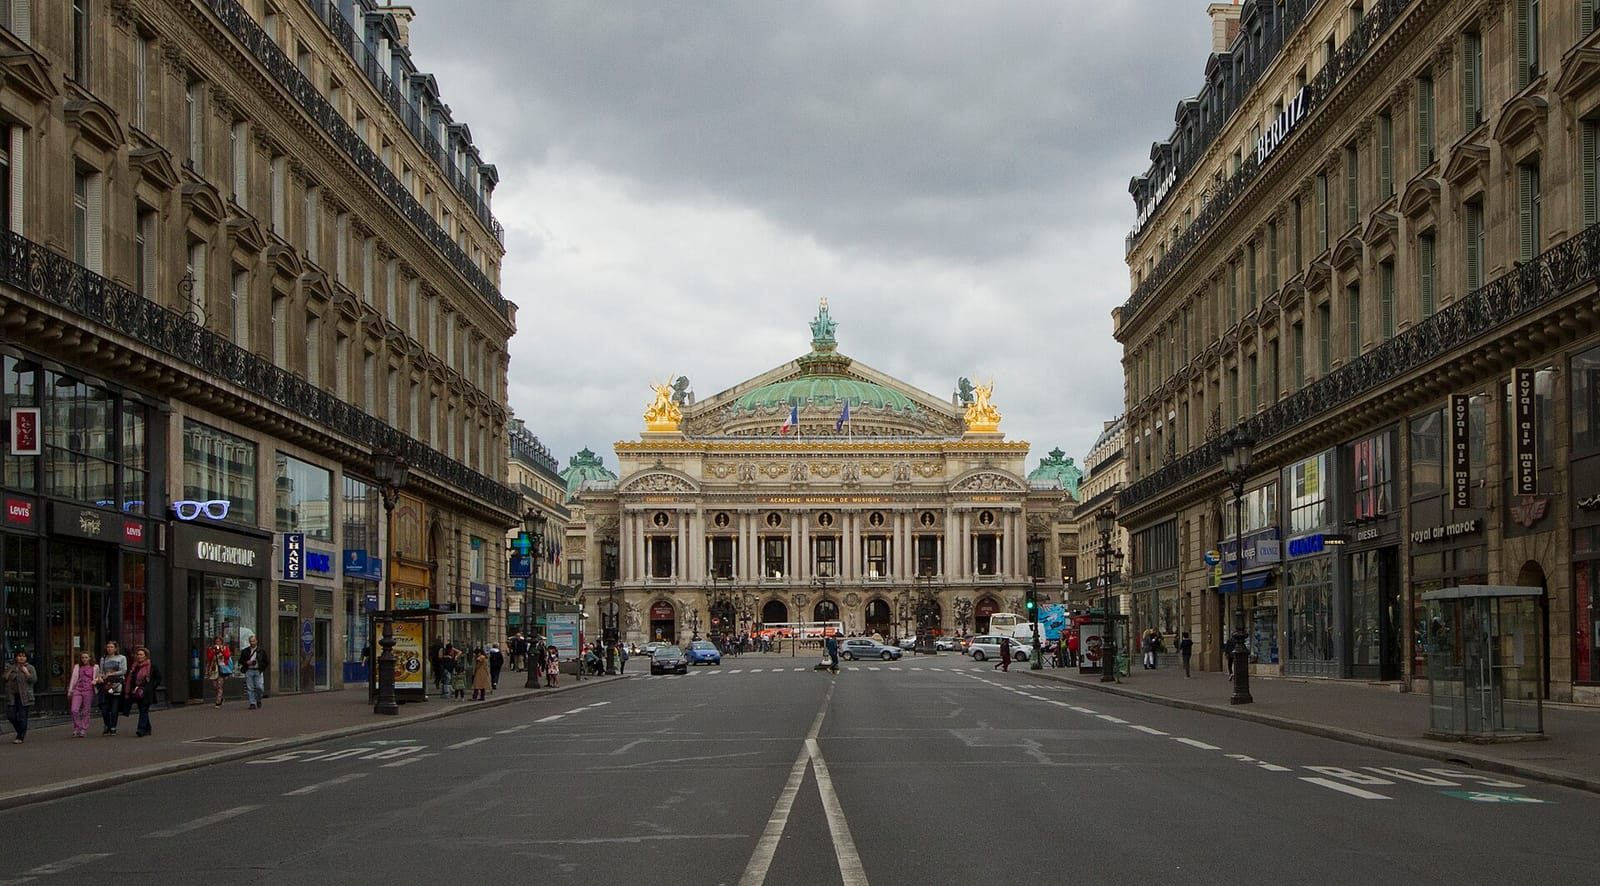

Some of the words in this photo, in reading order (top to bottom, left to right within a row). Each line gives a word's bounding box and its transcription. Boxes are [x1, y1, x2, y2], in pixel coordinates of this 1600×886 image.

[1257, 86, 1305, 166] BERLITZ
[1156, 166, 1176, 206] maroc
[1520, 372, 1530, 415] royal
[1456, 398, 1465, 437] royal
[1521, 422, 1531, 446] air
[1456, 443, 1465, 465] air
[1520, 453, 1533, 491] maroc
[1455, 471, 1467, 506] maroc
[1357, 528, 1378, 541] DIESEL
[1410, 528, 1431, 543] royal
[1433, 525, 1444, 538] air
[1446, 520, 1475, 535] maroc
[288, 535, 300, 578] CHANGE
[1300, 766, 1526, 788] BUS
